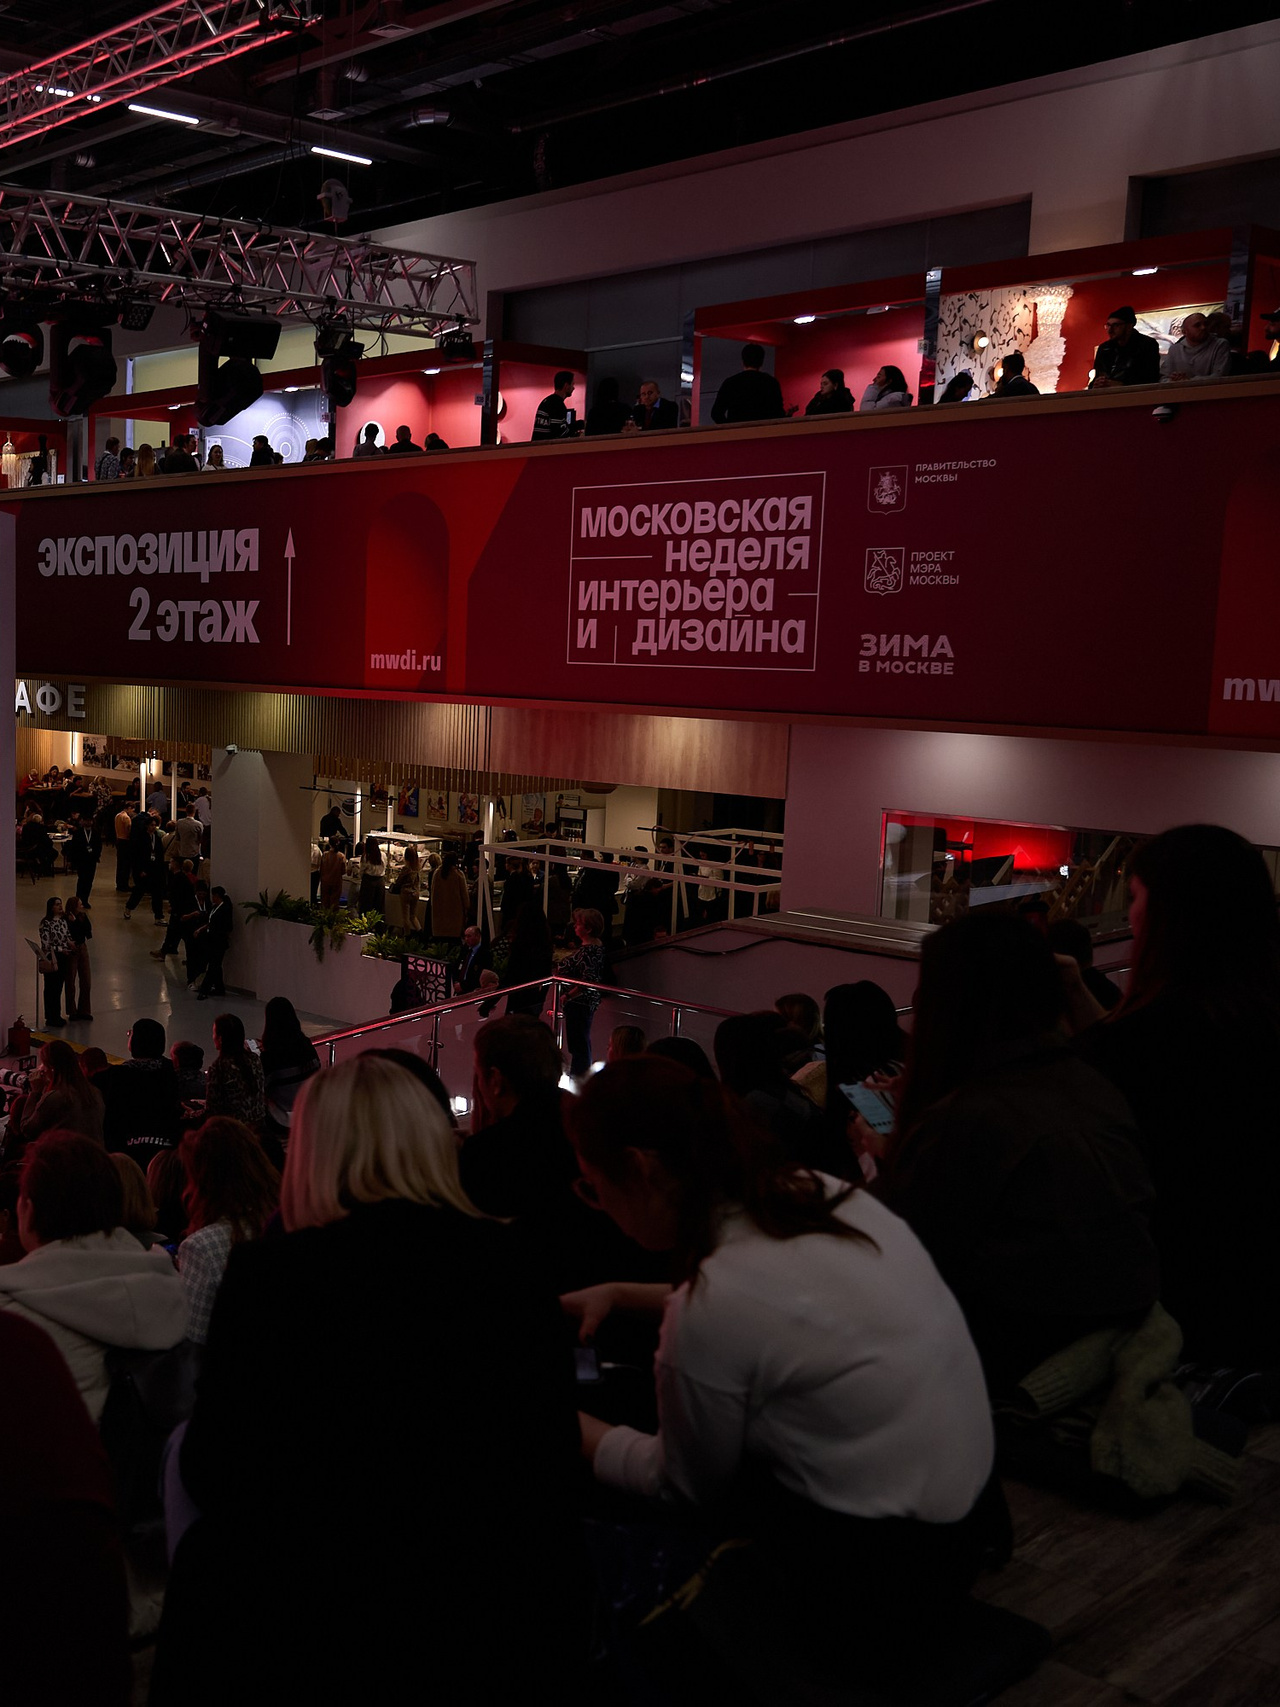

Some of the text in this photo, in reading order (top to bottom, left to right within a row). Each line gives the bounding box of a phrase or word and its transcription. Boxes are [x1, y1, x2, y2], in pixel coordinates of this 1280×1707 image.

[914, 458, 998, 473] ПРАВИТЕЛЬСТВО
[914, 473, 959, 485] МОСКВЫ
[580, 495, 813, 539] московская
[665, 536, 811, 577] неделя
[910, 550, 956, 562] ПРОЕКТ
[910, 562, 943, 574] МЭРА
[909, 574, 960, 586] МОСКВЫ
[577, 577, 775, 619] интерьера
[128, 586, 260, 644] 2 этаж
[576, 613, 806, 656] и дизайна
[859, 633, 955, 659] ЗИМА
[370, 649, 442, 672] mwdi.ru
[858, 660, 955, 676] В МОСКВЕ
